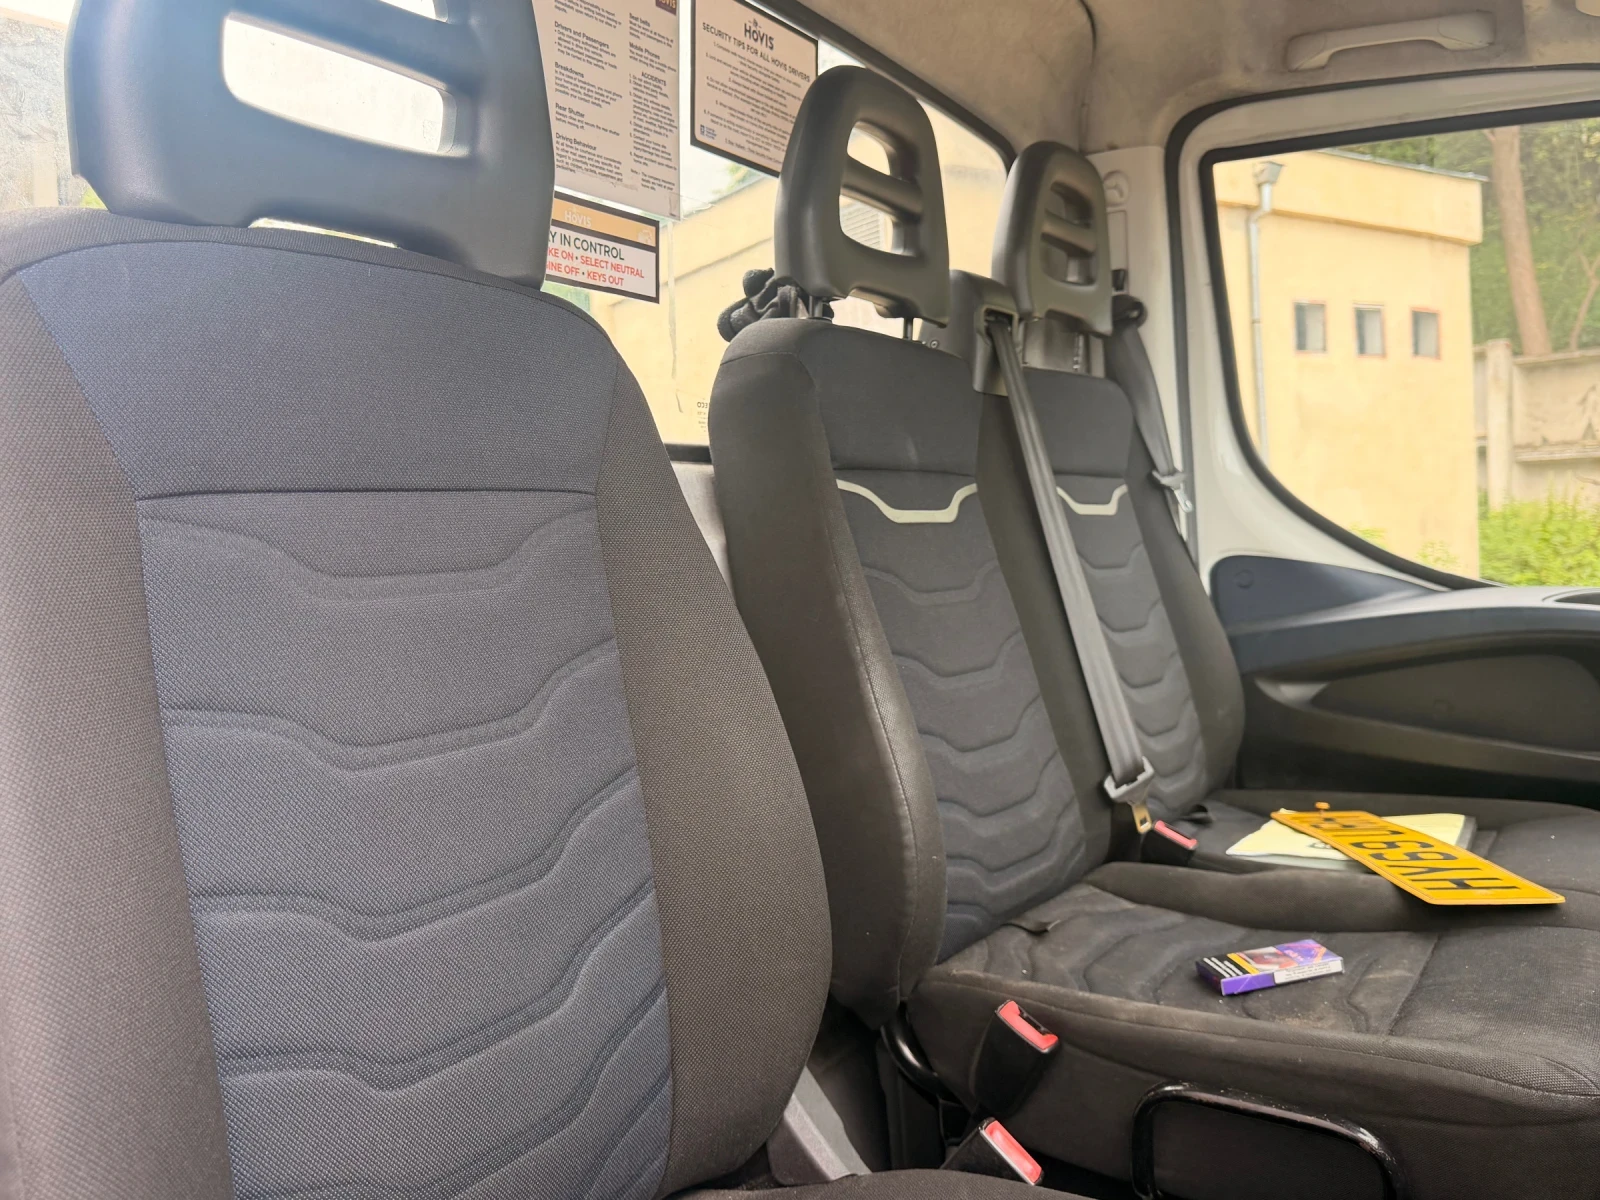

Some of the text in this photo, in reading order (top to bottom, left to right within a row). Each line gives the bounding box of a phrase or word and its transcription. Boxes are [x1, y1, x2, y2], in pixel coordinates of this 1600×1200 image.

[555, 21, 609, 49] Drivers and Passengers
[744, 23, 775, 51] HOVIS
[629, 42, 660, 60] Mobile Phones
[702, 22, 811, 83] SECURITY TIPS FOR ALL HOVIS DRIVERS
[555, 62, 584, 78] Breakdowns
[556, 103, 585, 118] Rear Shutter
[556, 132, 597, 152] Driving Behaviour
[564, 210, 592, 228] HOVIS
[560, 233, 571, 247] IN
[574, 238, 625, 260] CONTROL
[561, 250, 574, 261] ON
[580, 255, 609, 270] SELECT
[611, 262, 645, 279] NEUTRAL
[564, 265, 580, 277] OFF
[587, 270, 607, 283] KEYS
[608, 275, 625, 287] OUT
[1351, 840, 1521, 890] HY69
